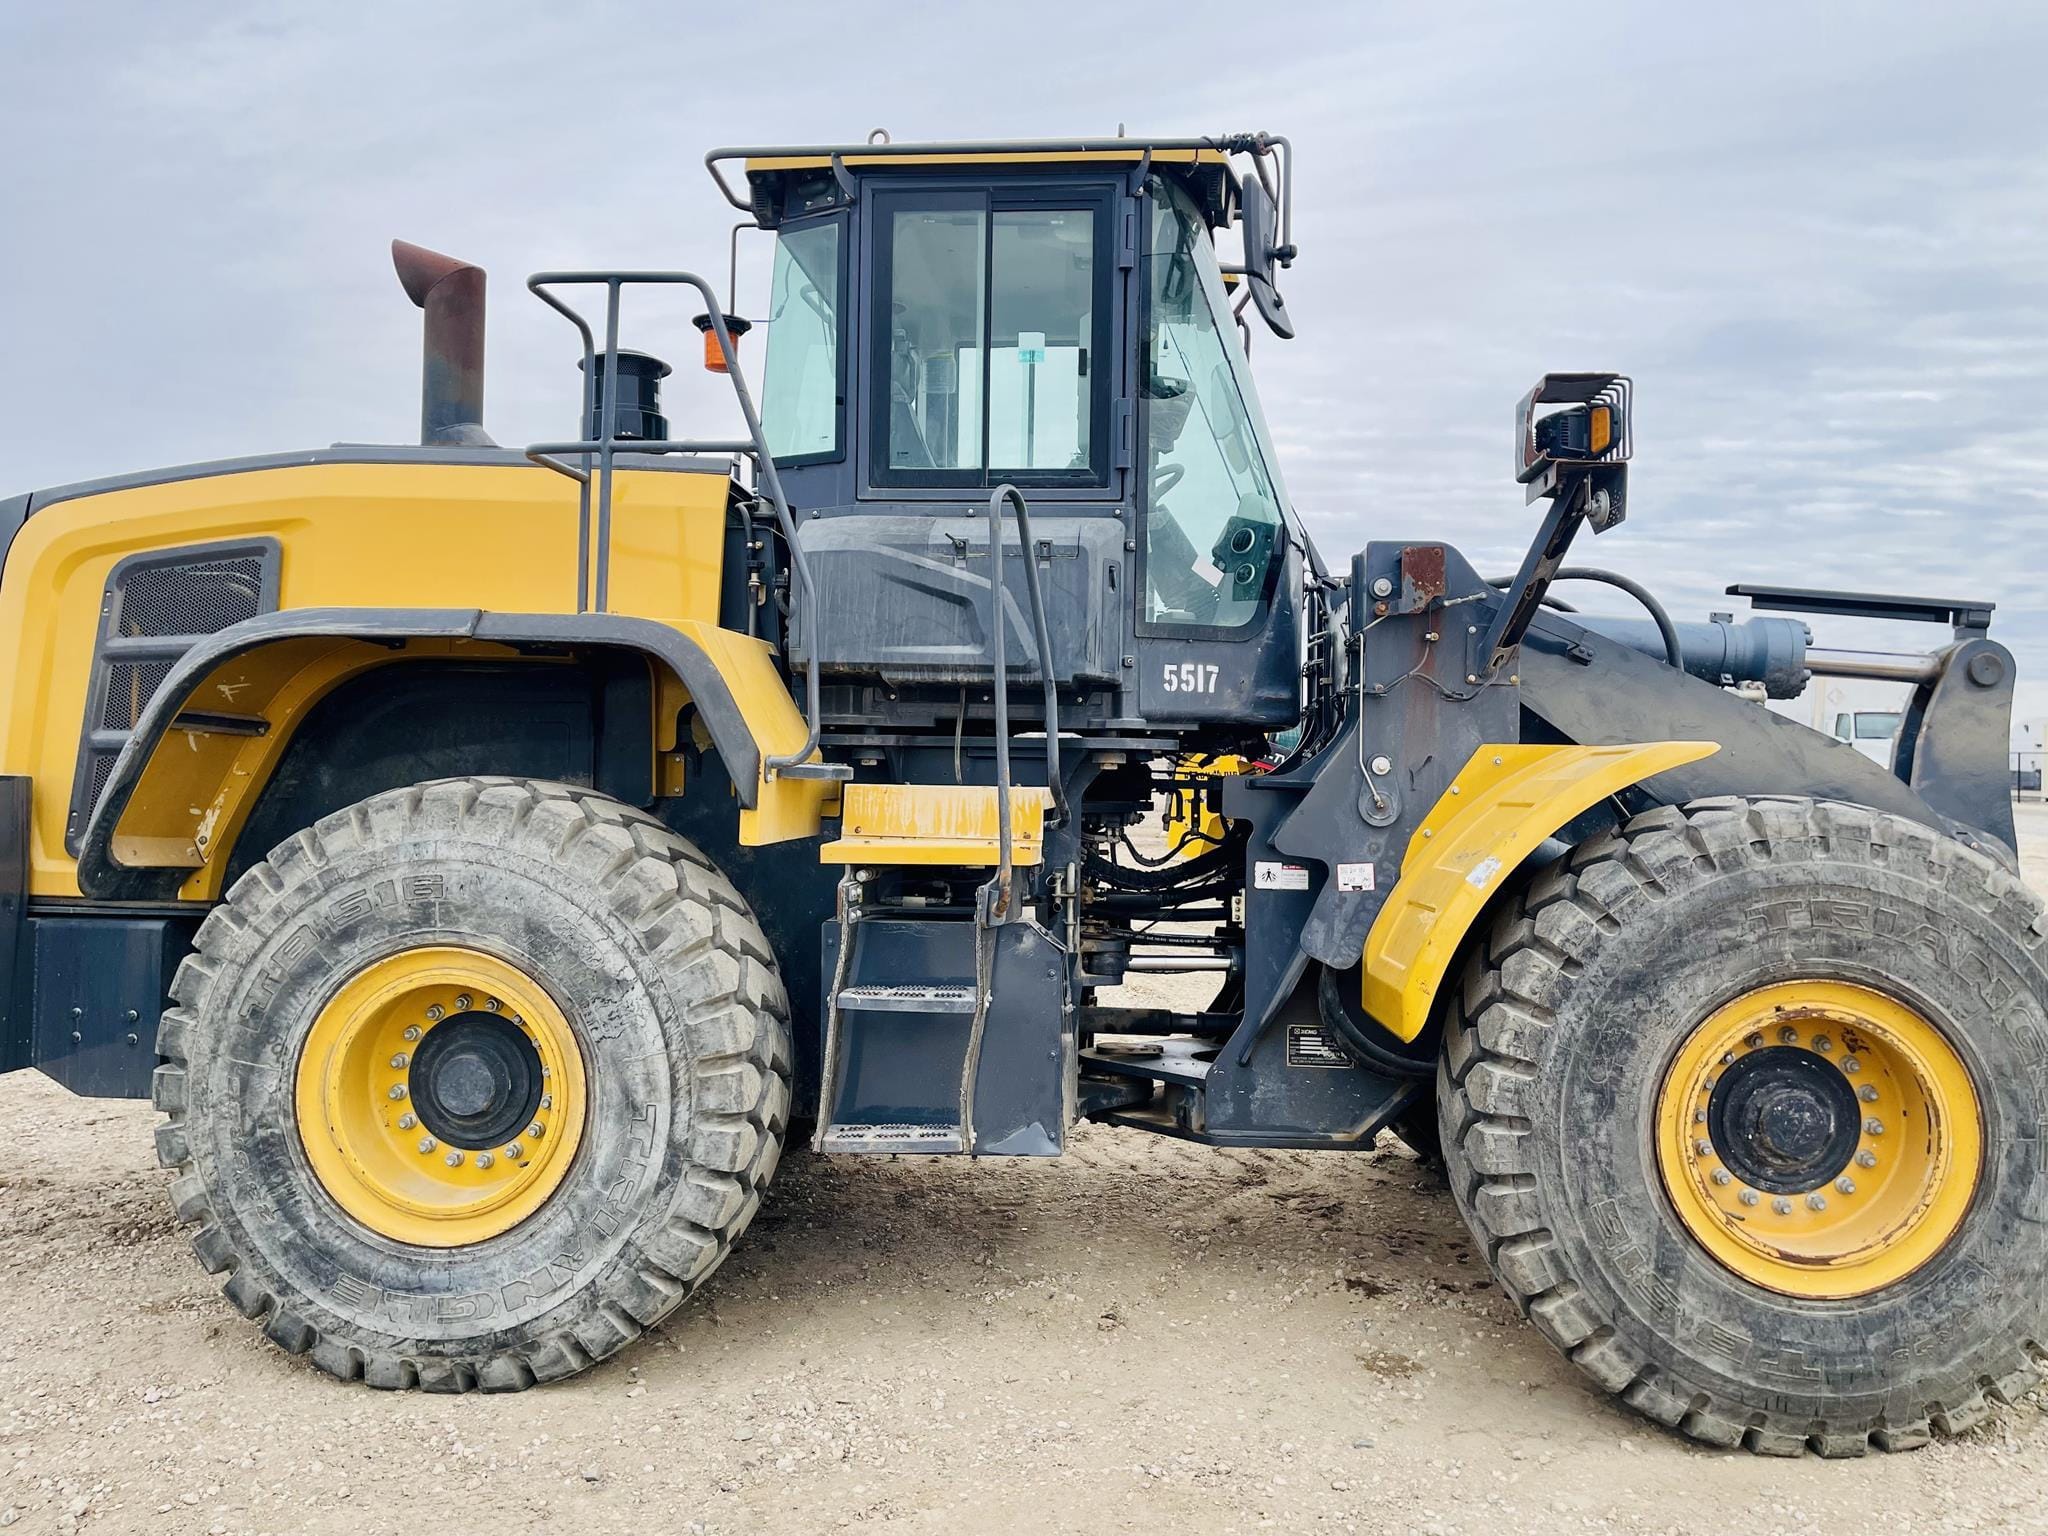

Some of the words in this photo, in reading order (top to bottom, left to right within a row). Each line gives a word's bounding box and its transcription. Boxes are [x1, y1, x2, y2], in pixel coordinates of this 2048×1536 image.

[1163, 664, 1219, 693] 5517
[1744, 898, 2048, 1173] TRIANGL
[330, 1104, 657, 1325] TRIANGLE
